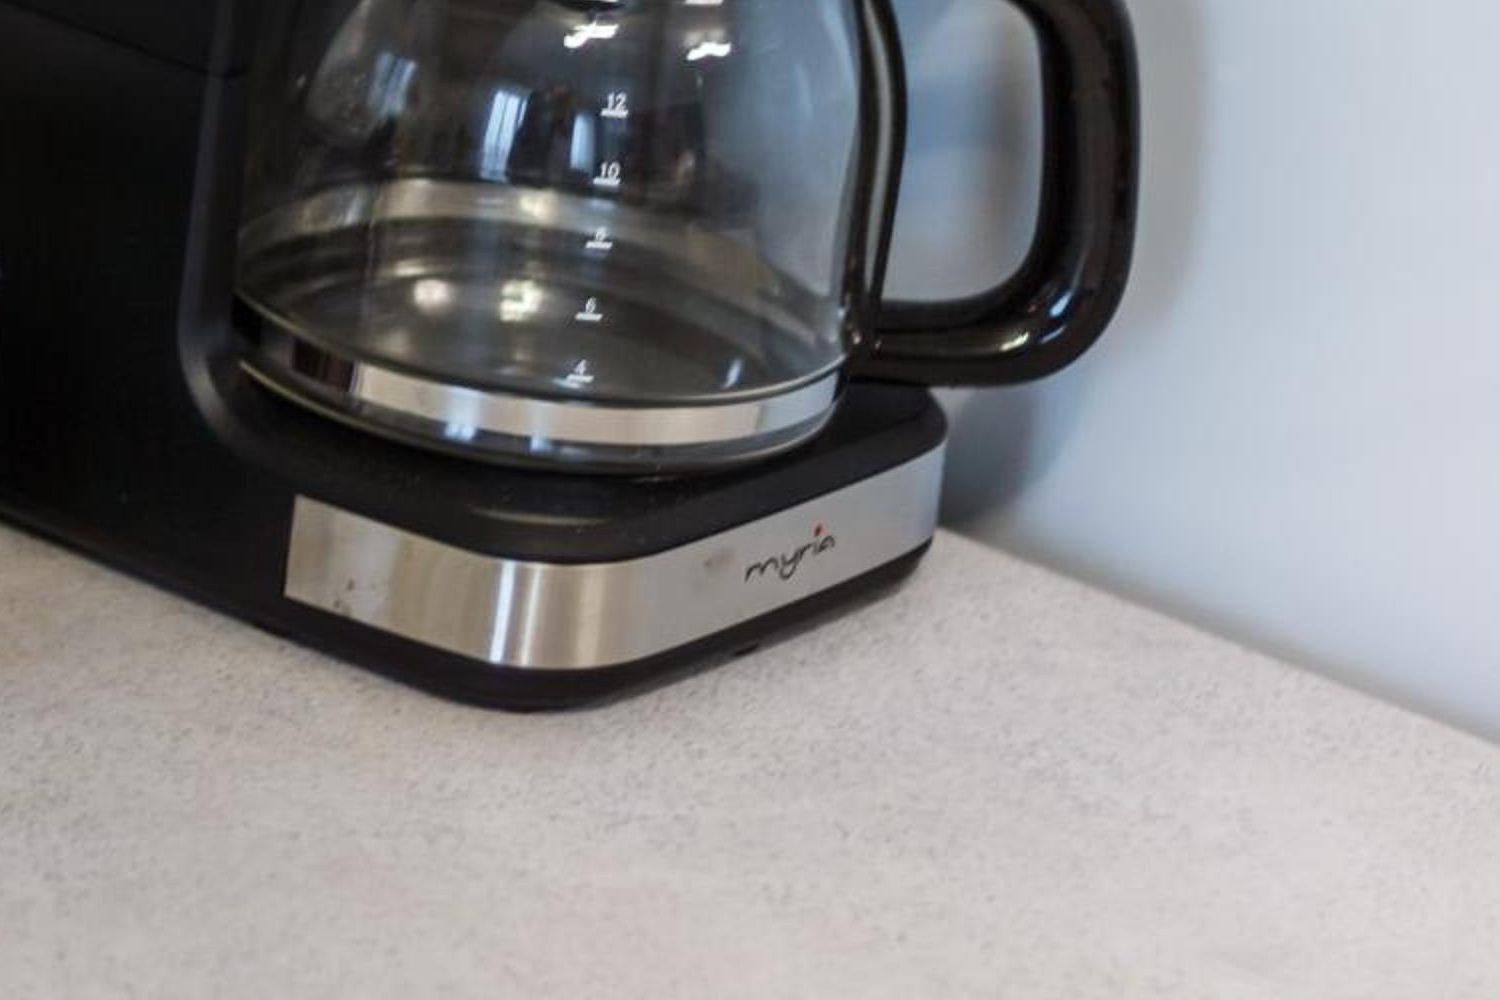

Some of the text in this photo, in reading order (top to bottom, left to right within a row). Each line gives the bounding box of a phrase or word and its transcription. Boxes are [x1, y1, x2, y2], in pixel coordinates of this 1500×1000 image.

[605, 92, 627, 111] 12
[599, 161, 621, 179] 10
[744, 524, 836, 583] myria
